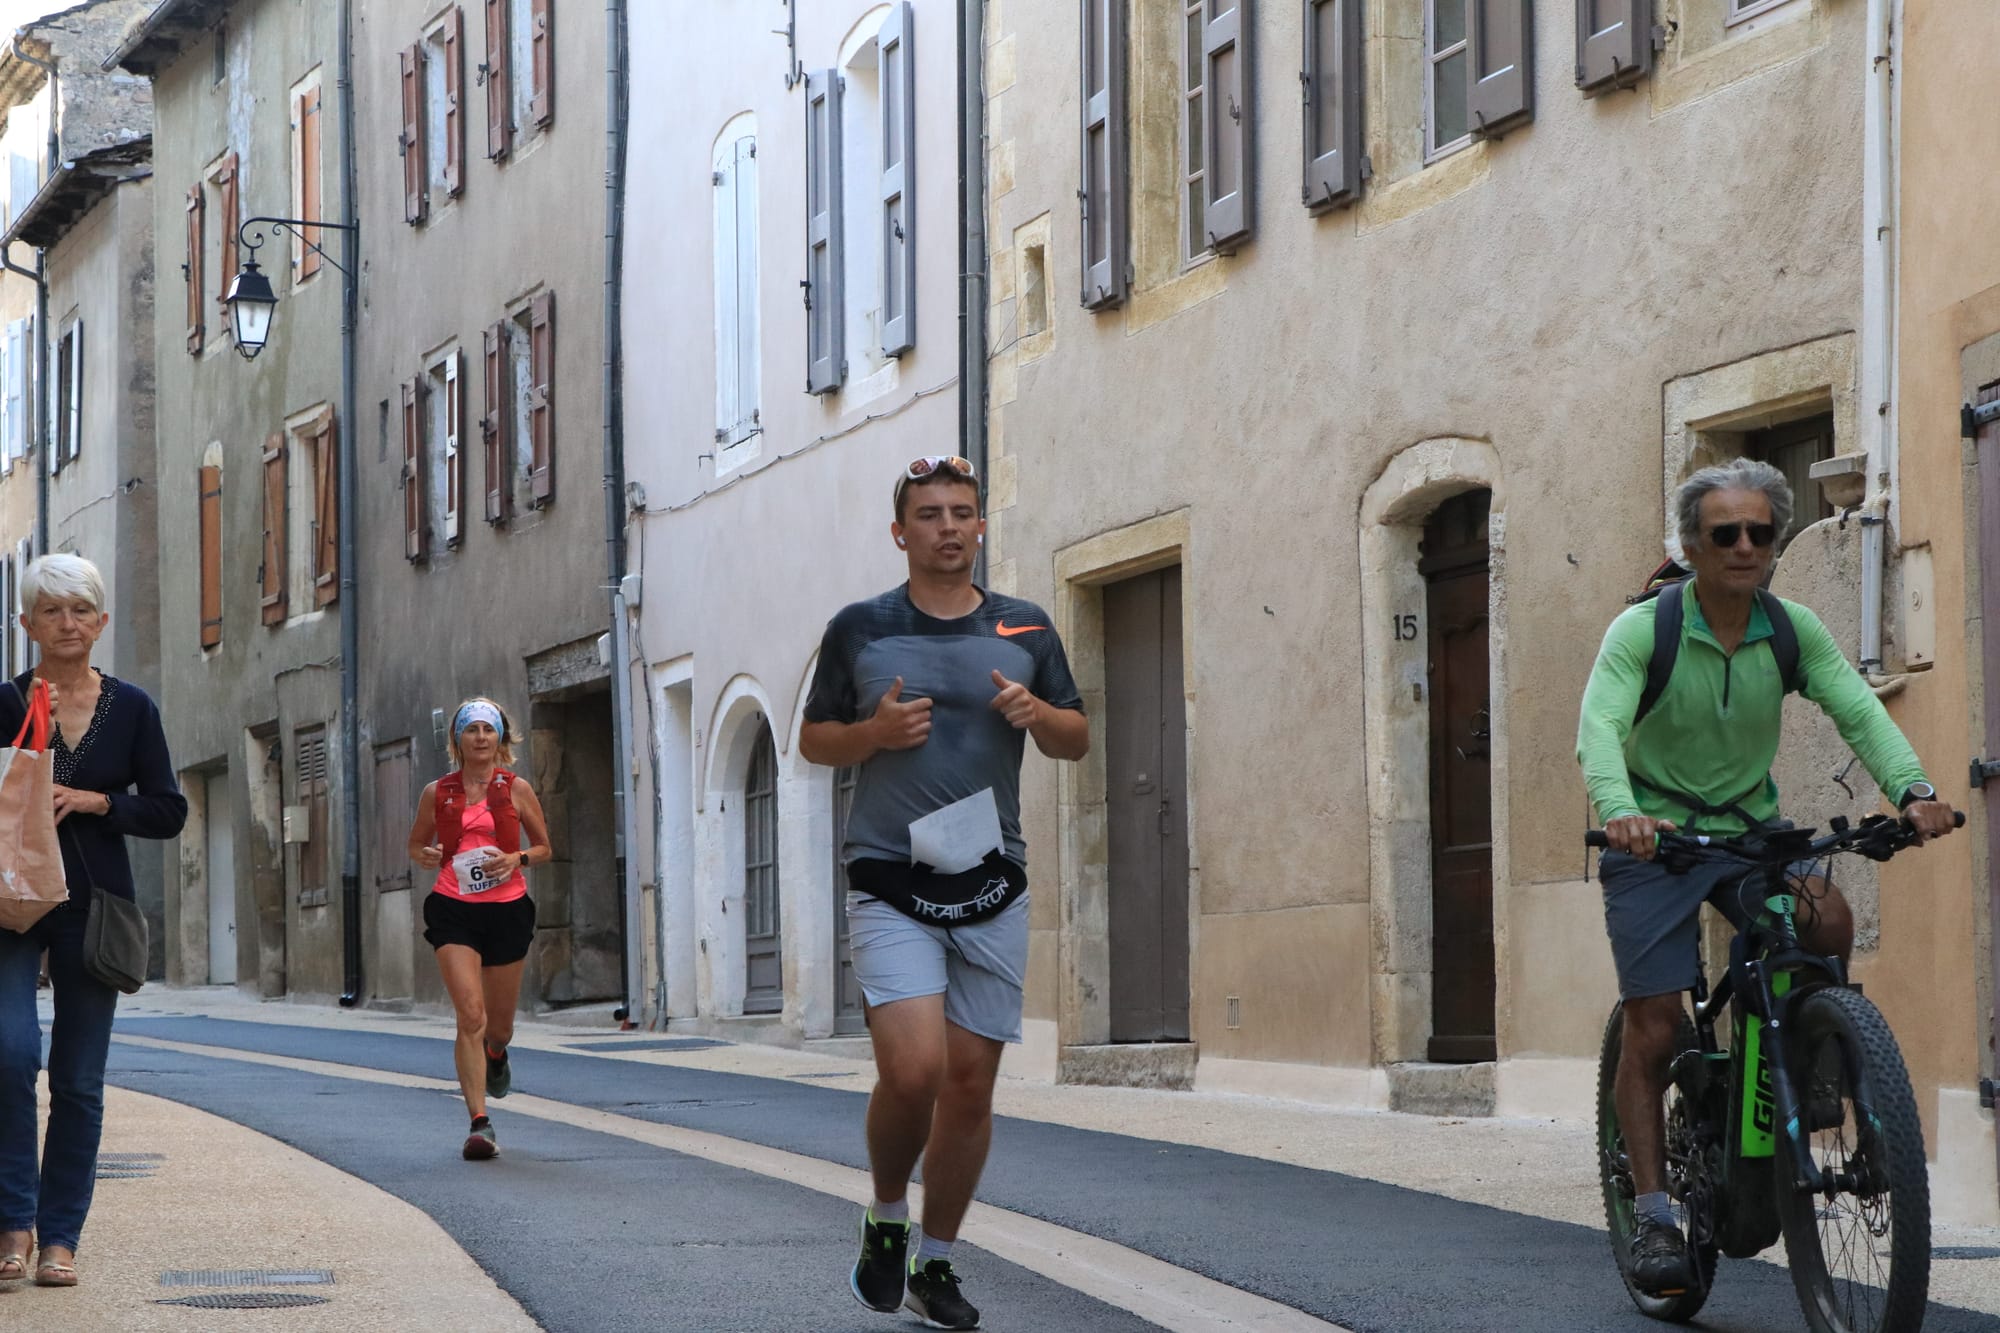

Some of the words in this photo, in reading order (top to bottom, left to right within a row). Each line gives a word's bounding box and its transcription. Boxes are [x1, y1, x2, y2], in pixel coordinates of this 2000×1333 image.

[1393, 615, 1417, 640] 15
[913, 895, 971, 919] TRAIL
[976, 877, 1009, 912] RUN
